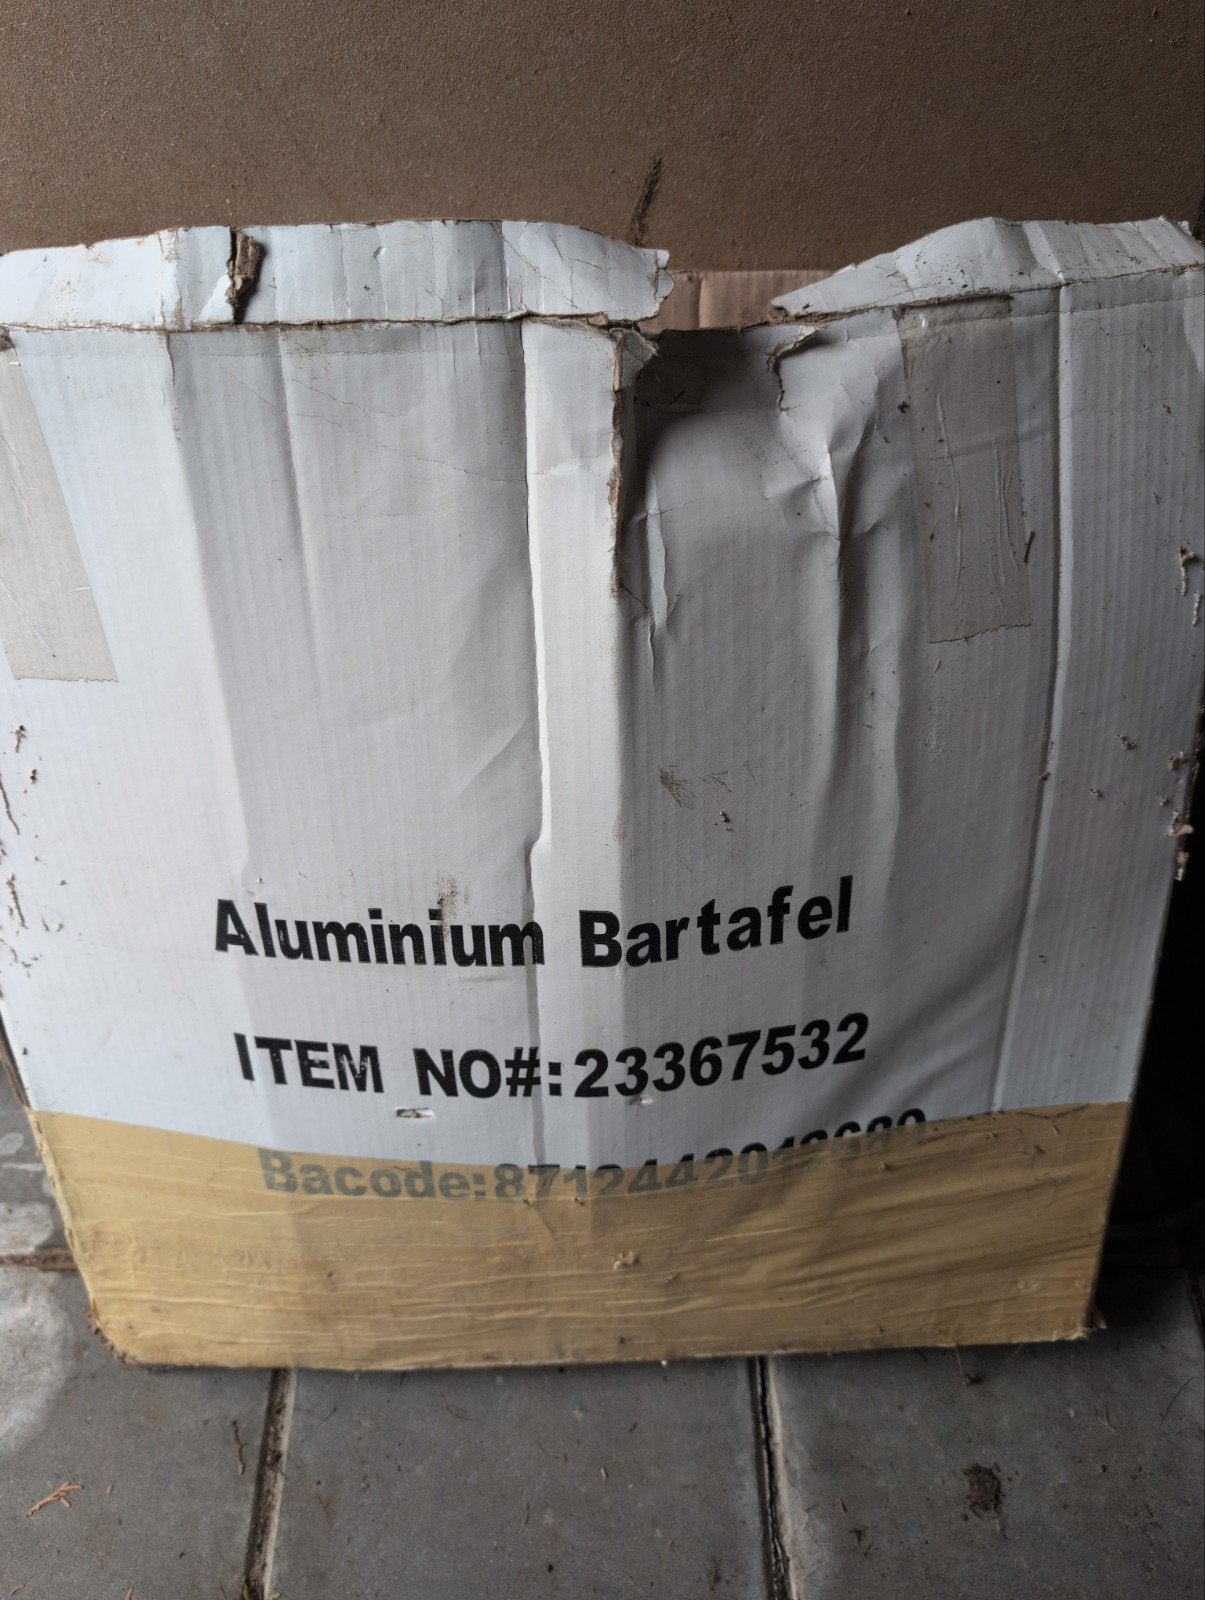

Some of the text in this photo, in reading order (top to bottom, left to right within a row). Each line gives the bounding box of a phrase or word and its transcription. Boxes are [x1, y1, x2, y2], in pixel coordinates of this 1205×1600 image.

[215, 875, 853, 968] Aluminium Bartafel
[234, 1012, 869, 1098] ITEM NO#:23367532
